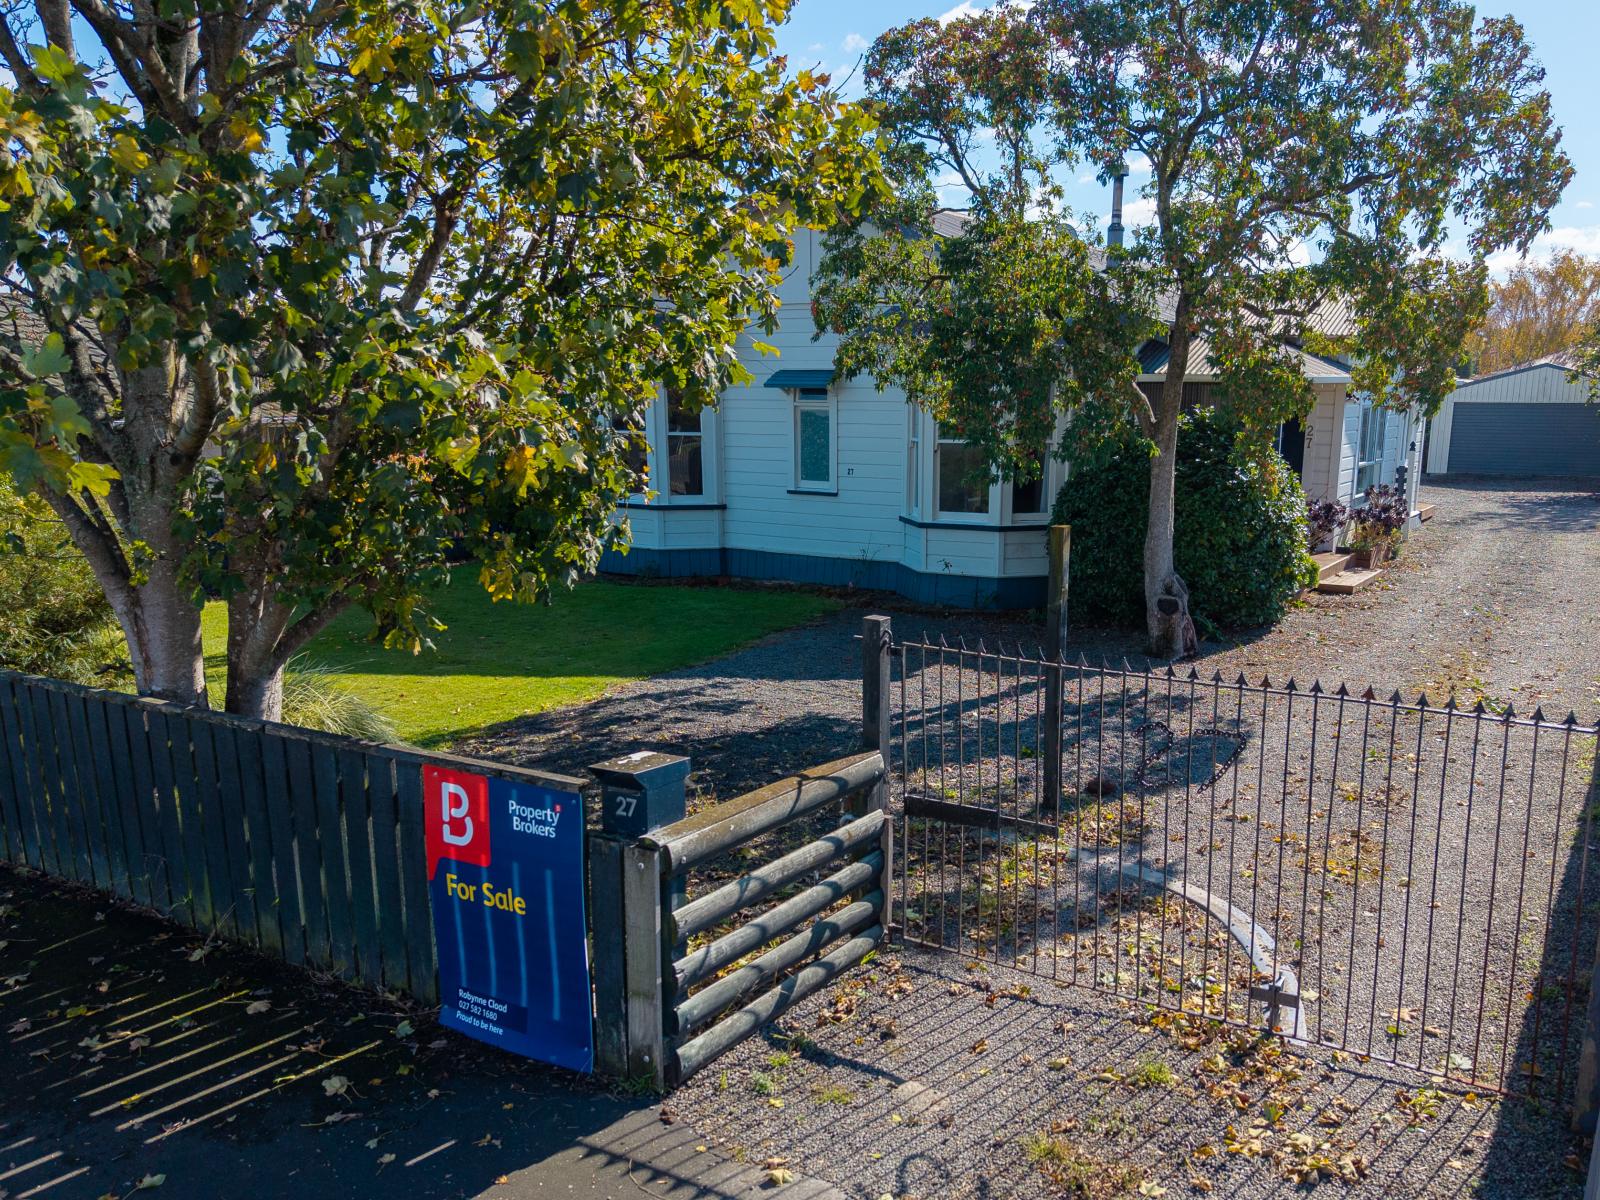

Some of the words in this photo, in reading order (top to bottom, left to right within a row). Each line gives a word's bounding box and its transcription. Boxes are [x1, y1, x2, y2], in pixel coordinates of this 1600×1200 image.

[508, 800, 560, 826] Property
[615, 795, 637, 818] 27
[513, 816, 556, 838] Brokers
[446, 873, 477, 902] For
[481, 882, 526, 916] Sale
[458, 989, 487, 1006] Robynne
[458, 1000, 470, 1010] 027
[470, 1004, 481, 1016] 582
[456, 1010, 473, 1023] Proud
[473, 1018, 480, 1027] to
[480, 1019, 489, 1030] be
[489, 1023, 503, 1035] here
